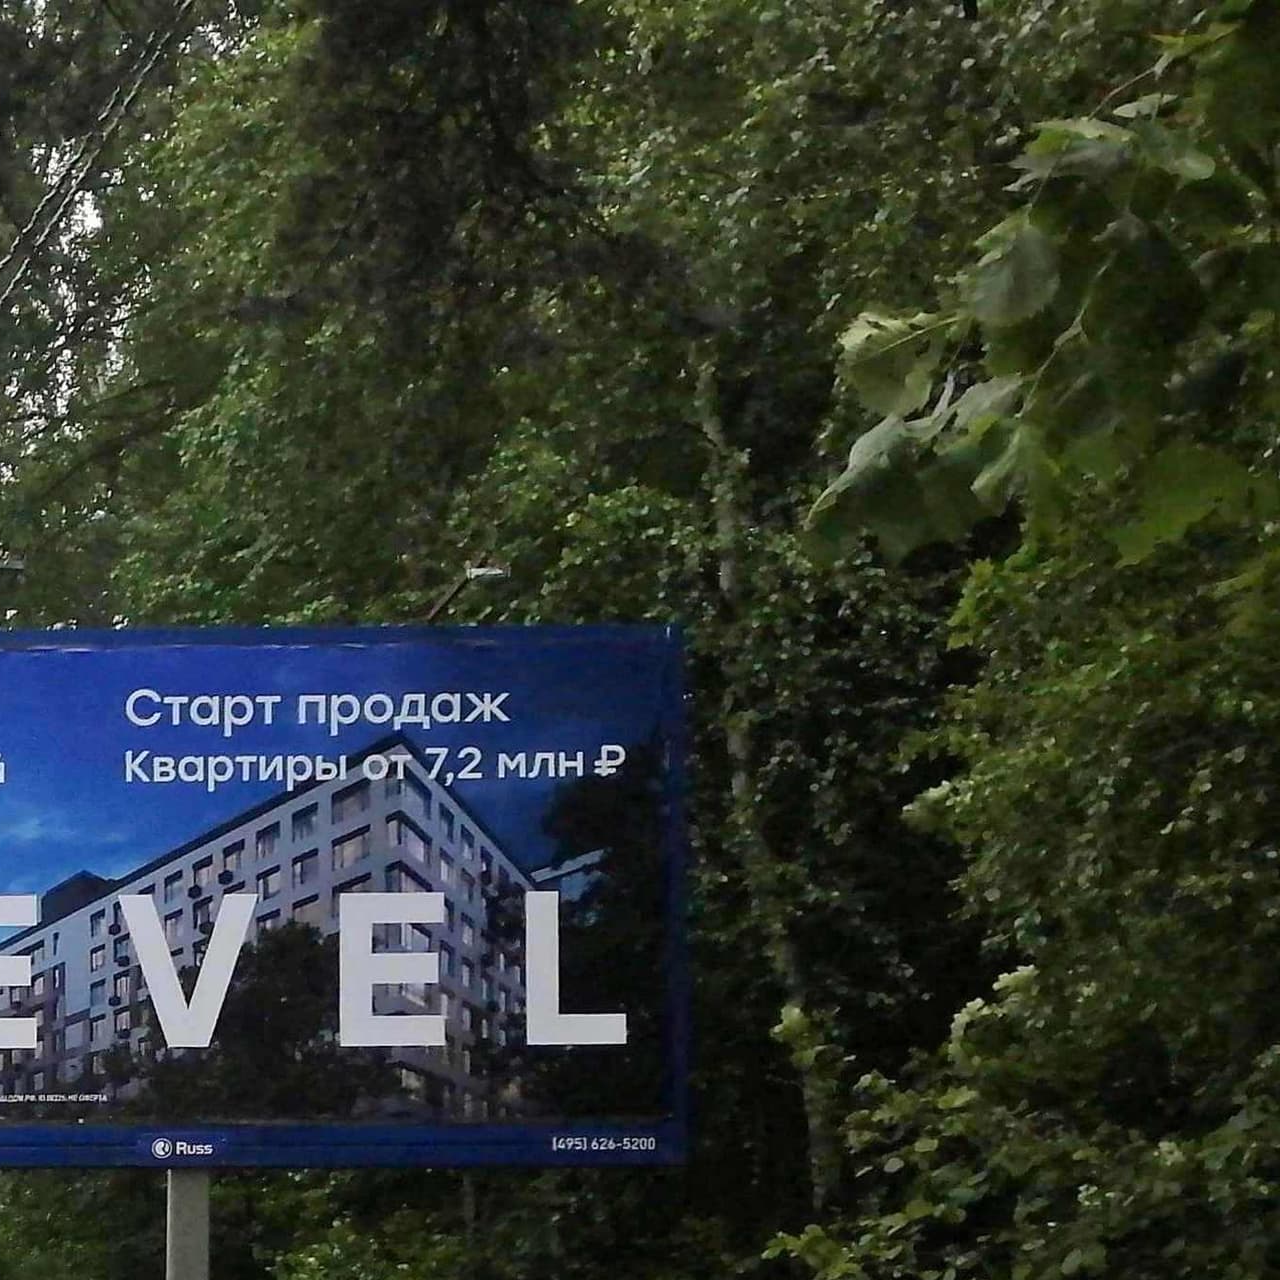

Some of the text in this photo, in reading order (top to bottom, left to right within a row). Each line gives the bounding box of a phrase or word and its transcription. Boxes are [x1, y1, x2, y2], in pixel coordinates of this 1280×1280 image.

[125, 688, 512, 737] Старт продаж
[124, 749, 348, 792] Квартиры
[362, 751, 412, 781] от
[425, 746, 483, 787] 7,2
[496, 748, 584, 779] млн
[175, 1141, 214, 1155] Russ
[591, 1137, 656, 1151] 626-5200
